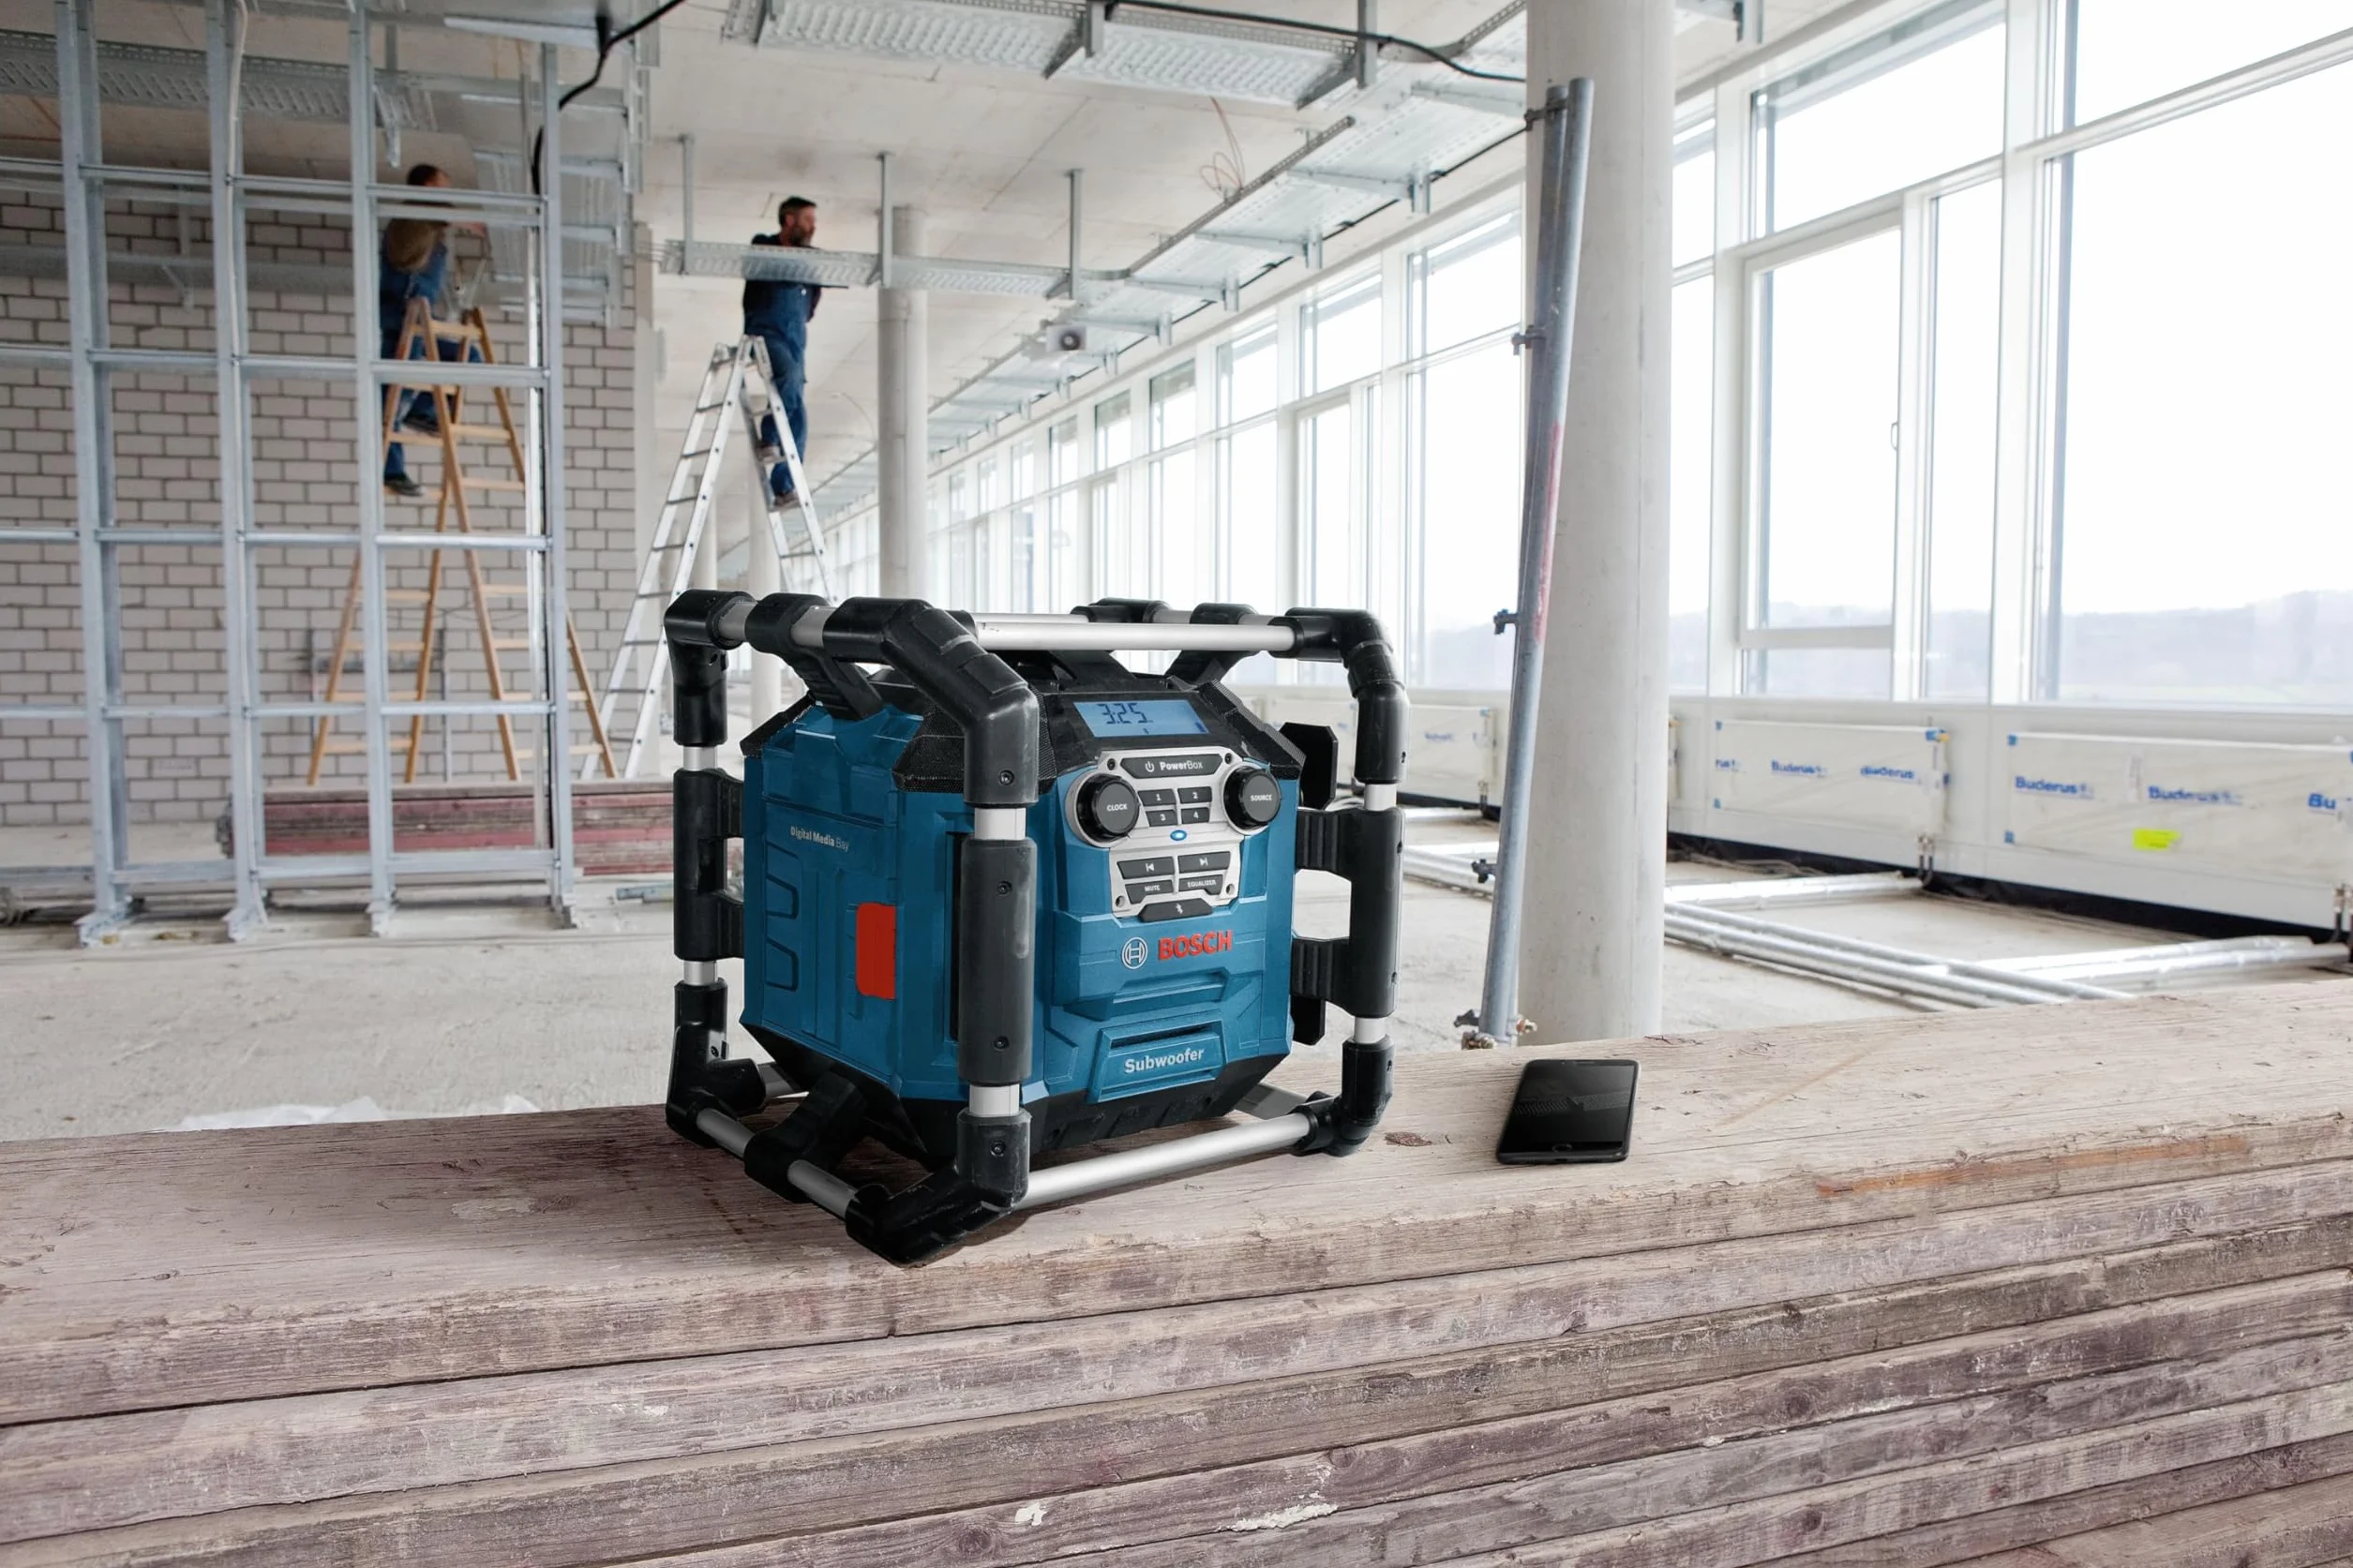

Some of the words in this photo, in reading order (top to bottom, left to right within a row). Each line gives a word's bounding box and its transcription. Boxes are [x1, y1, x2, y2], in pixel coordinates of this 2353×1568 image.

[1159, 760, 1204, 771] PowerBox
[1155, 793, 1162, 801] 1
[1192, 791, 1198, 799] 2
[1251, 793, 1273, 802] SOURCE
[1106, 803, 1128, 813] CLOCK
[1160, 814, 1166, 822] 3
[1192, 810, 1199, 819] 4
[790, 825, 812, 841] Digital
[813, 831, 835, 847] Media
[835, 836, 848, 853] Bay
[1145, 884, 1162, 892] MUTE
[1187, 879, 1217, 889] EQUALIZER
[1158, 929, 1233, 961] BOSCH
[1124, 1047, 1205, 1073] Subwoofer
